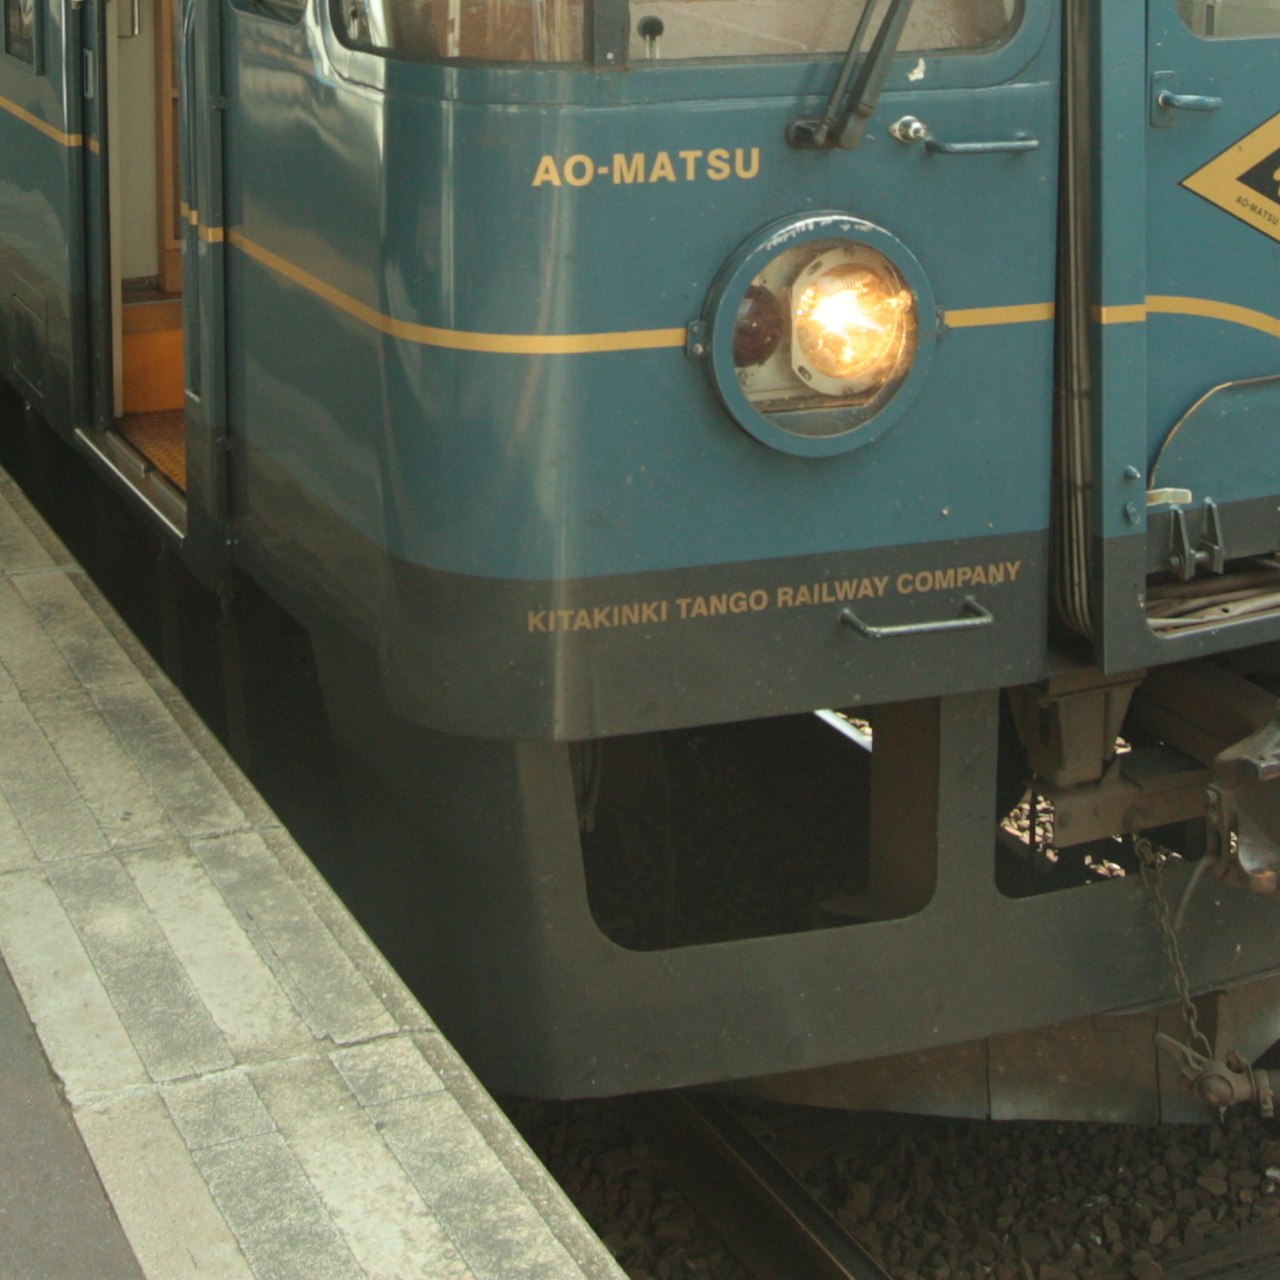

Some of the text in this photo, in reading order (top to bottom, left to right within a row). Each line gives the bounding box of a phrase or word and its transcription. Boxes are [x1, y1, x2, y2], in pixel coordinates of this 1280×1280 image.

[532, 147, 760, 187] AO-MATSU
[1235, 195, 1280, 226] AO-MATSU
[527, 560, 1022, 633] KITAKINKI TANGO RAILWAY COMPANY
